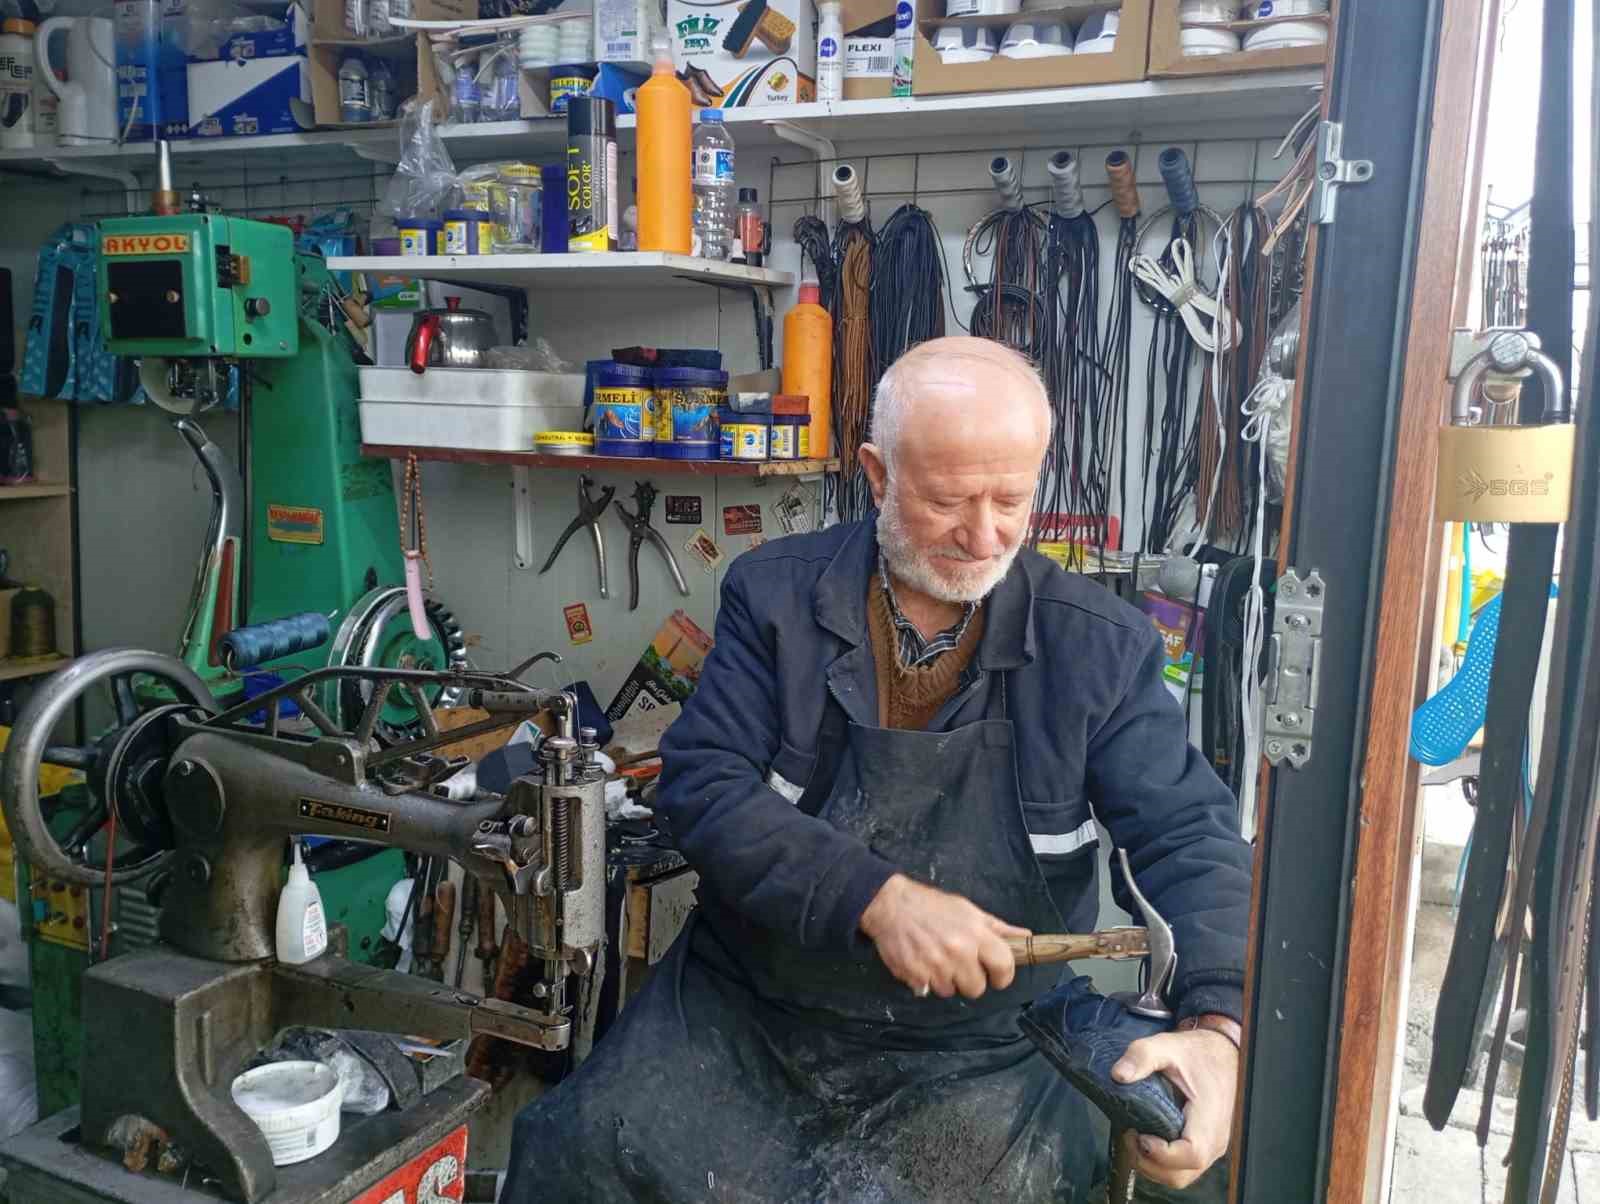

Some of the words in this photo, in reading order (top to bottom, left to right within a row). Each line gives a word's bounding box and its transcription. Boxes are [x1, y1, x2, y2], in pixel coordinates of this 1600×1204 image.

[847, 43, 882, 52] FLEXI
[582, 160, 592, 209] COLOR
[106, 236, 185, 252] AKYOL
[1489, 479, 1550, 497] SGS
